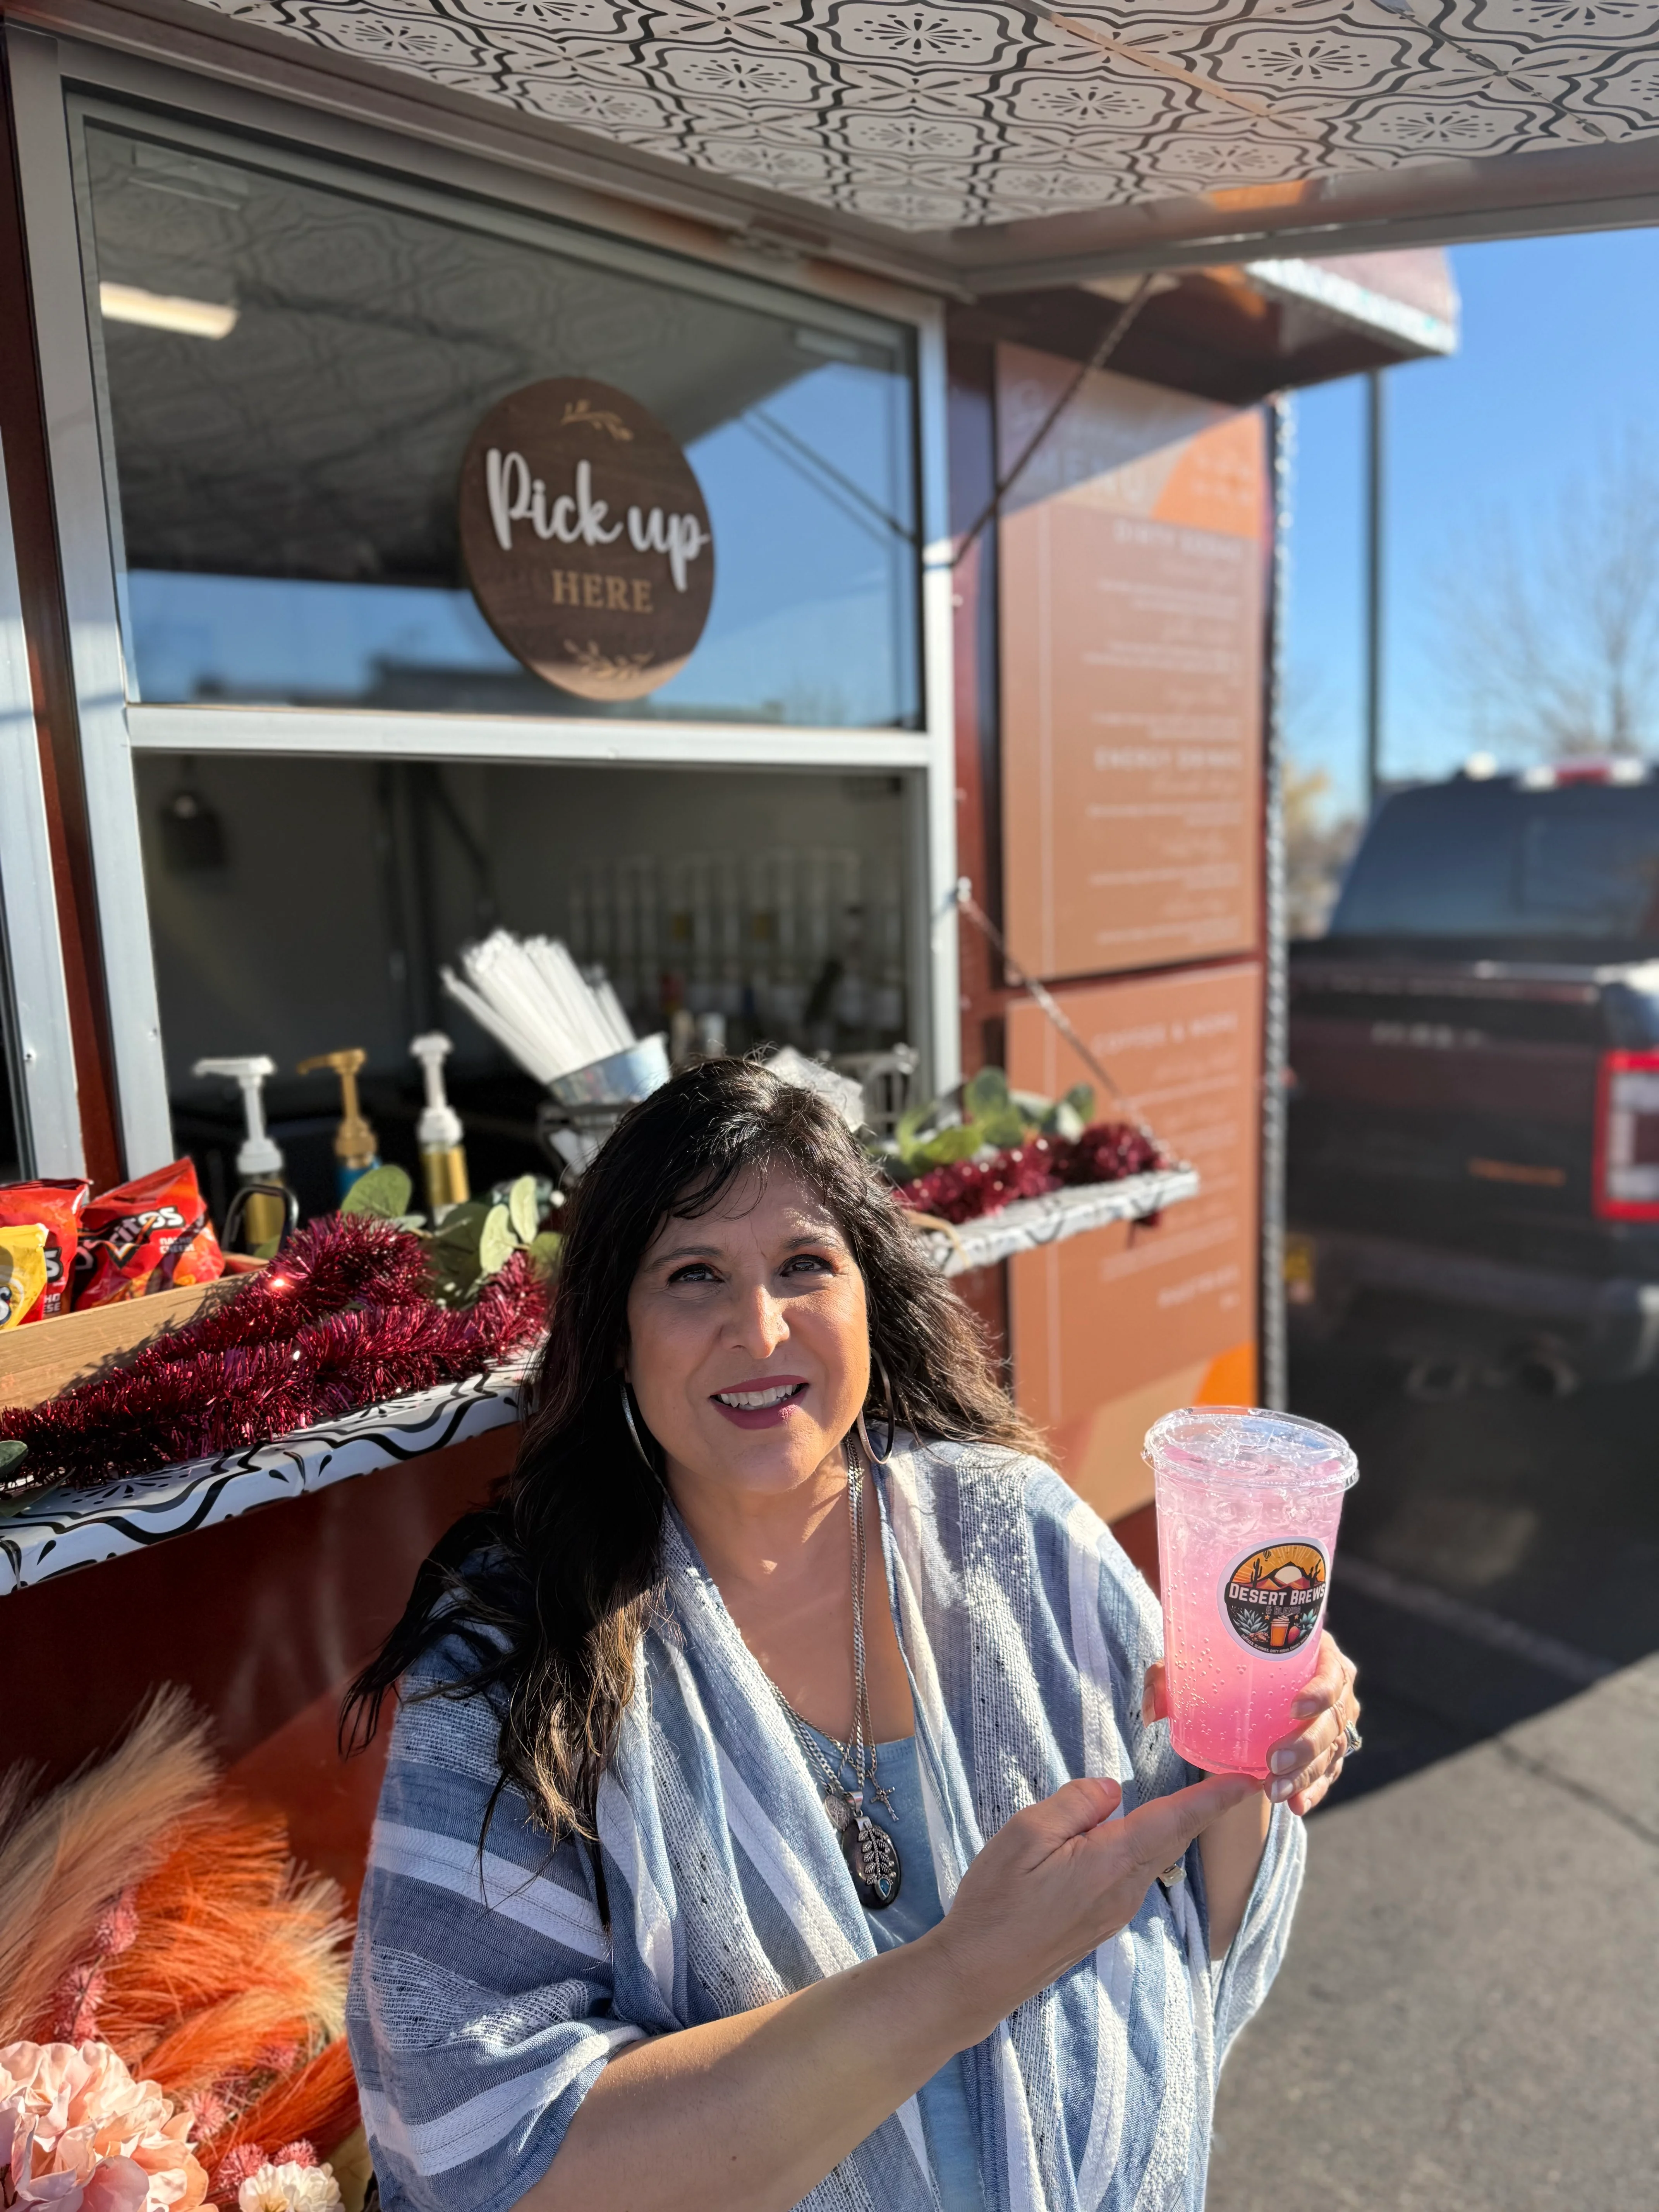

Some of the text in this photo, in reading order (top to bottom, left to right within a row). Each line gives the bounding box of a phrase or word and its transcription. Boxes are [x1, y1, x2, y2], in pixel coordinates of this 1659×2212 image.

[486, 448, 711, 593] Pick up
[551, 569, 654, 613] HERE
[1229, 1583, 1324, 1606] DESERT BREWS
